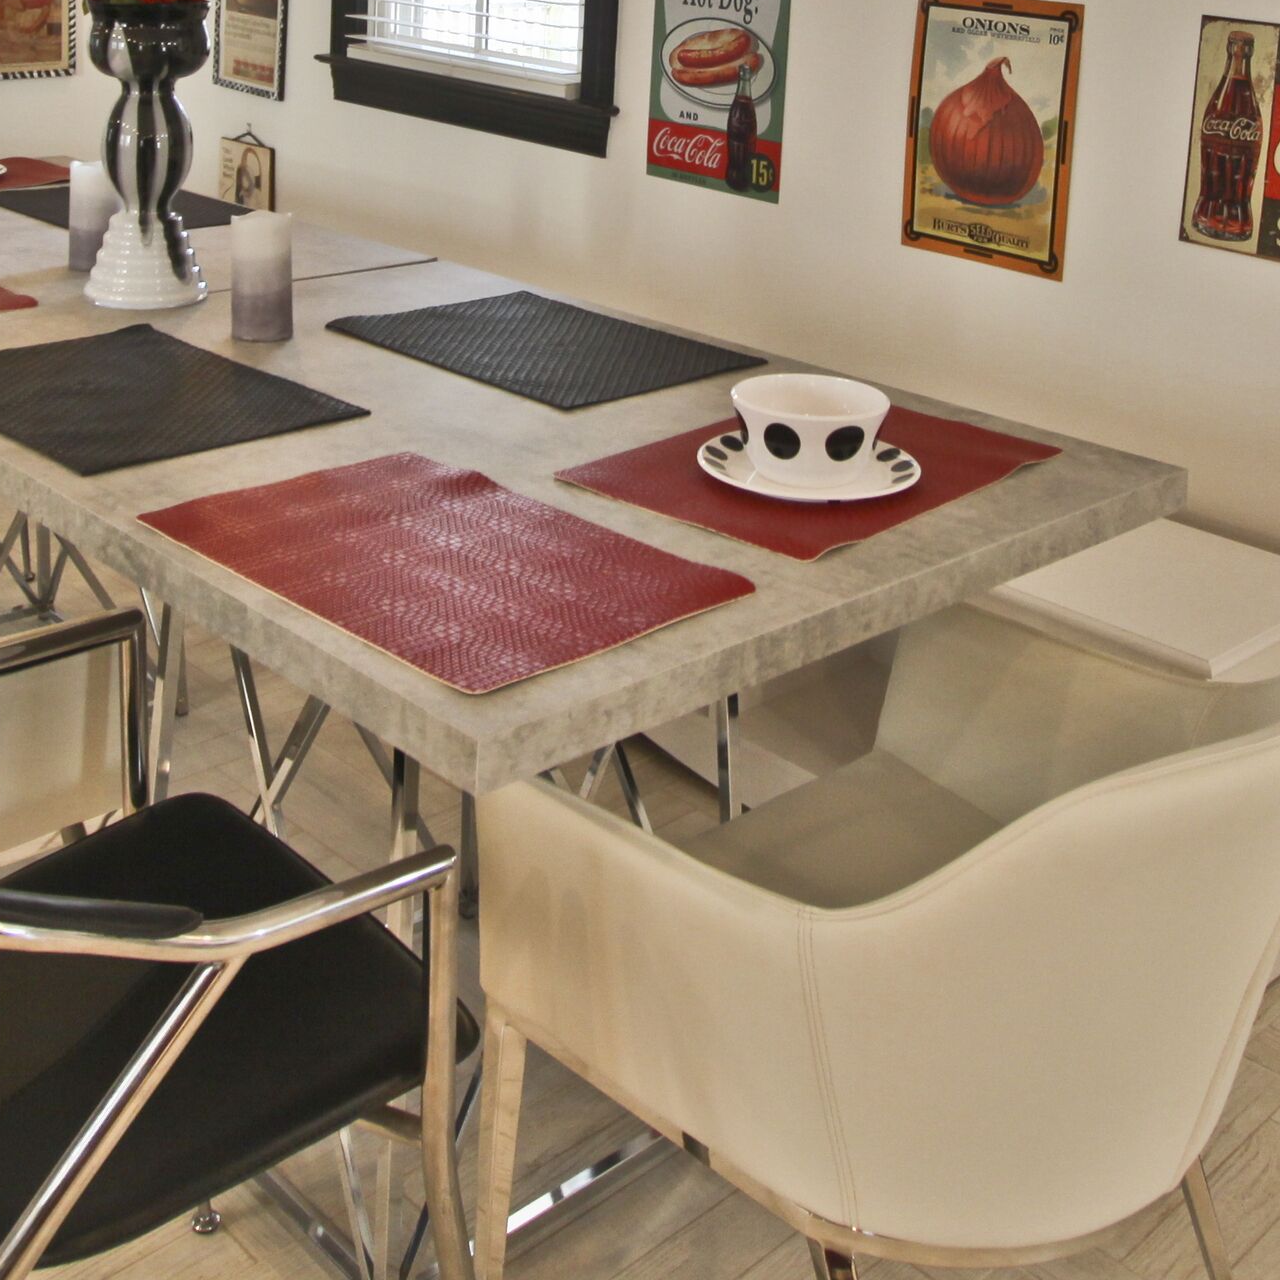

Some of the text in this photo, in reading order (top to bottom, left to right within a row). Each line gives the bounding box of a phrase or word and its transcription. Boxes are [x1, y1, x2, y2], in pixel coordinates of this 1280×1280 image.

[962, 17, 1030, 35] ONIONS
[679, 110, 699, 121] AND
[1202, 114, 1261, 141] Coca-Cola
[653, 127, 724, 168] Coca-Cola
